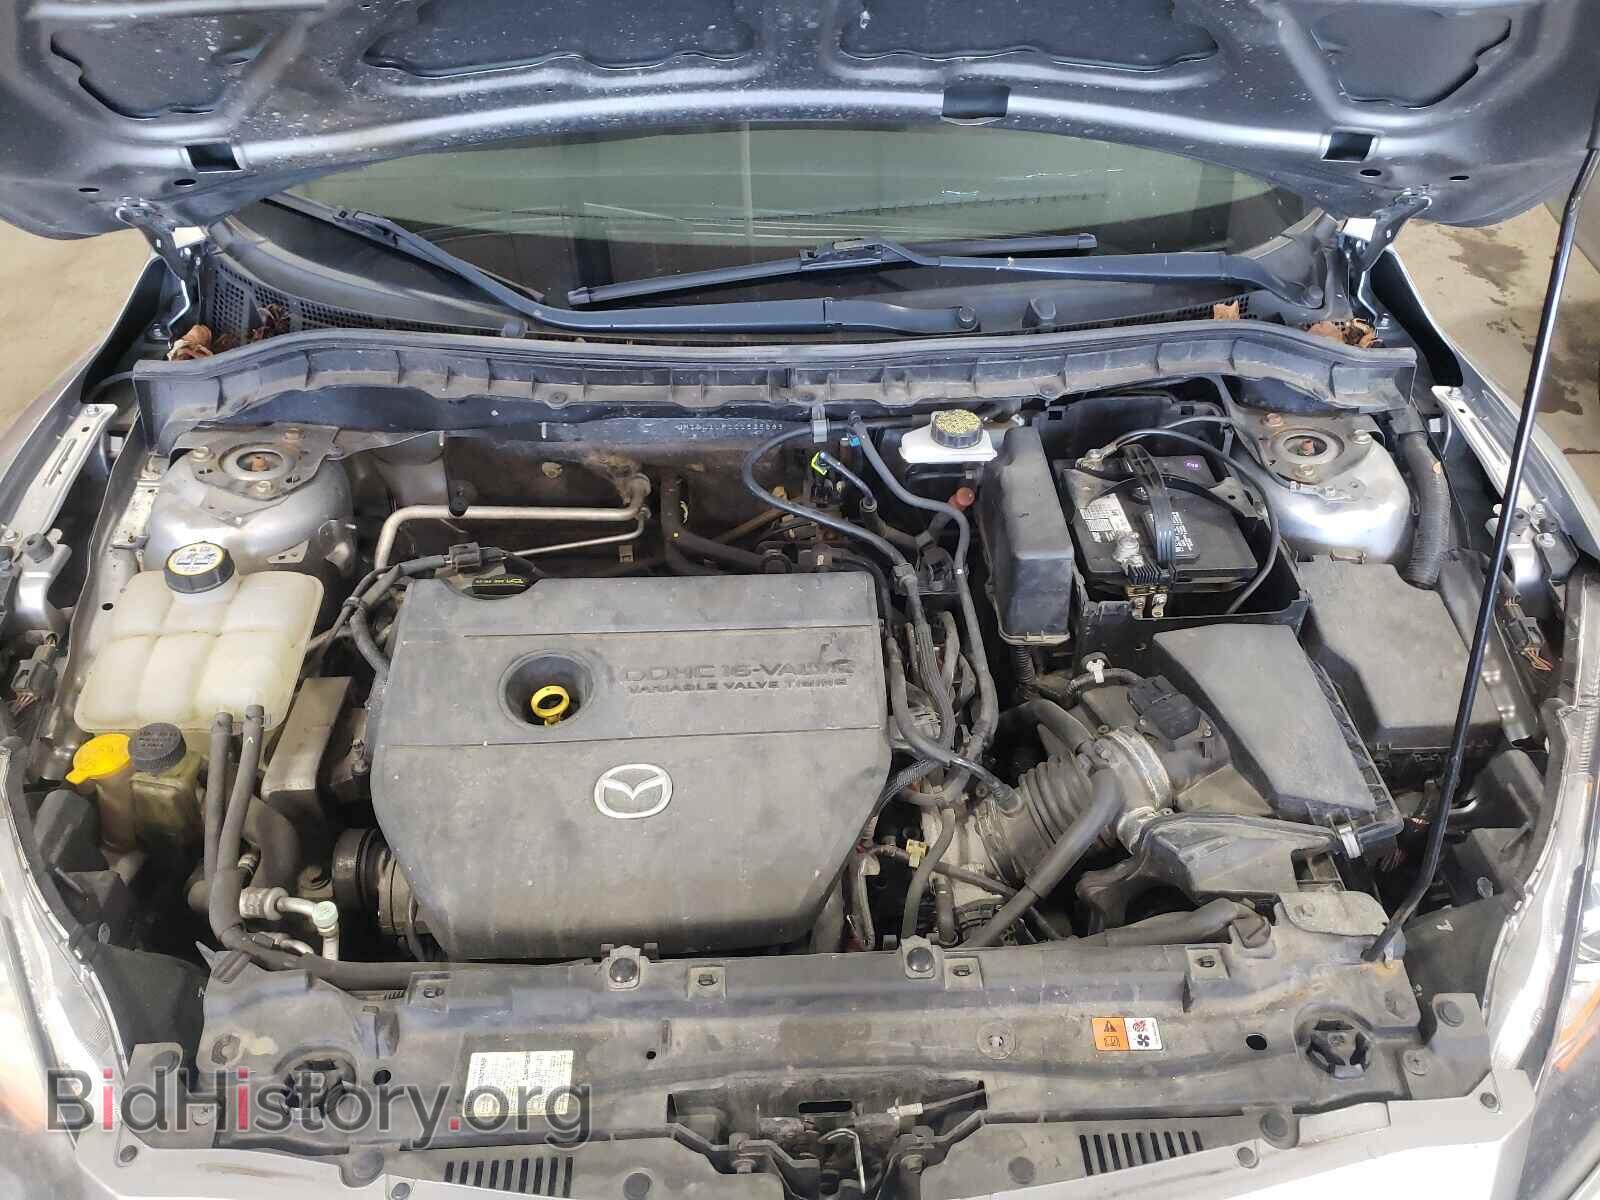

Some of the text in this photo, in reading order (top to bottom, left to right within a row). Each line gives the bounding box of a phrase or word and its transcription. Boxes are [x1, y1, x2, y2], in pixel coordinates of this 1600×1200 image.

[626, 664, 716, 682] DOHC
[628, 681, 719, 695] VARIABLE
[723, 680, 779, 691] VALVE
